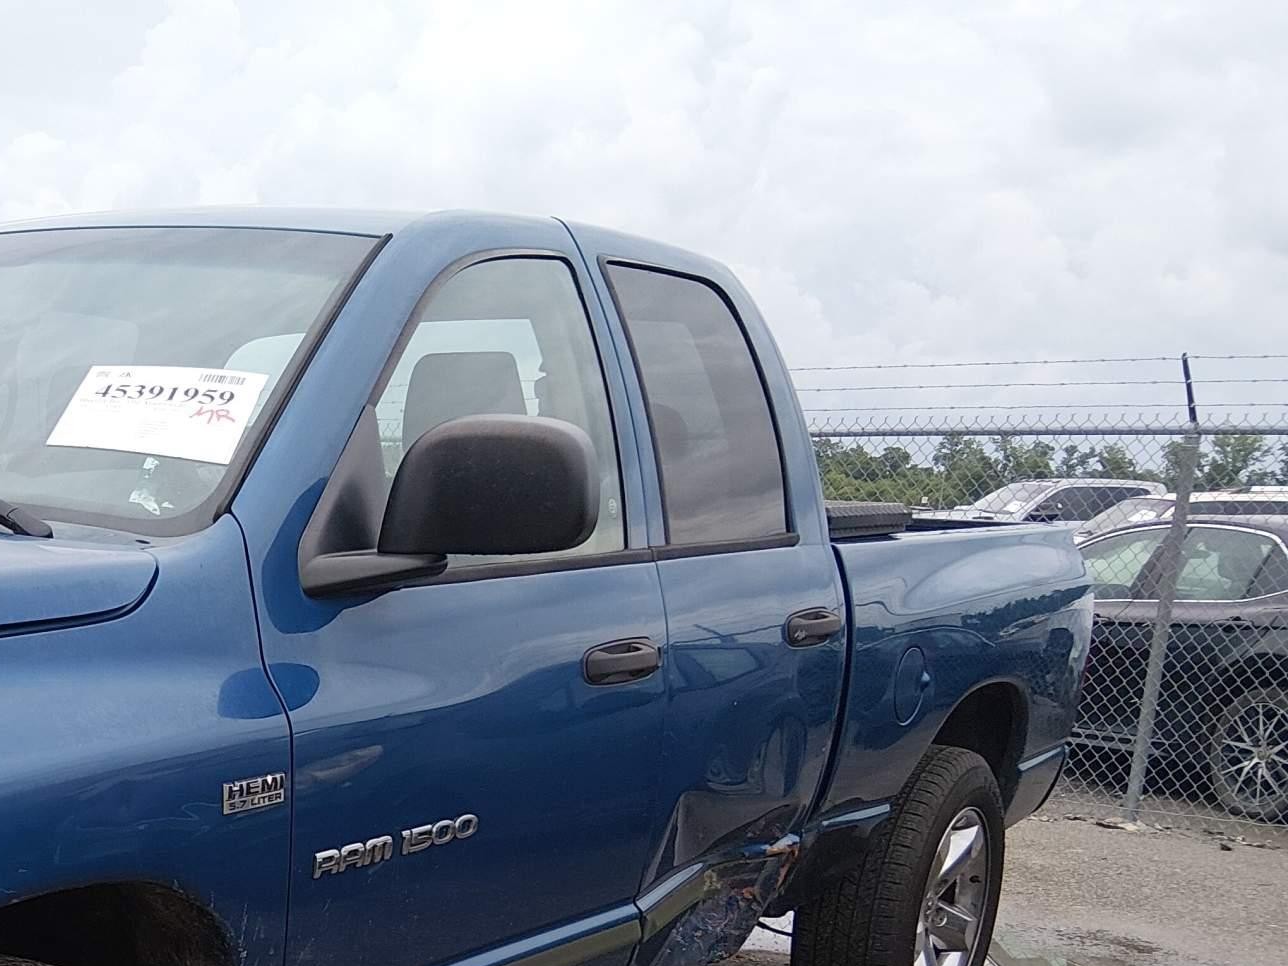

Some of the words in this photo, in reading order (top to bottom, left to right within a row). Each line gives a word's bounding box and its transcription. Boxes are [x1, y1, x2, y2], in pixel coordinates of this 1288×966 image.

[95, 384, 235, 406] 45391959
[226, 773, 286, 802] HEMI
[250, 792, 282, 807] LITER
[313, 835, 393, 880] RAM
[401, 814, 479, 856] 1500
